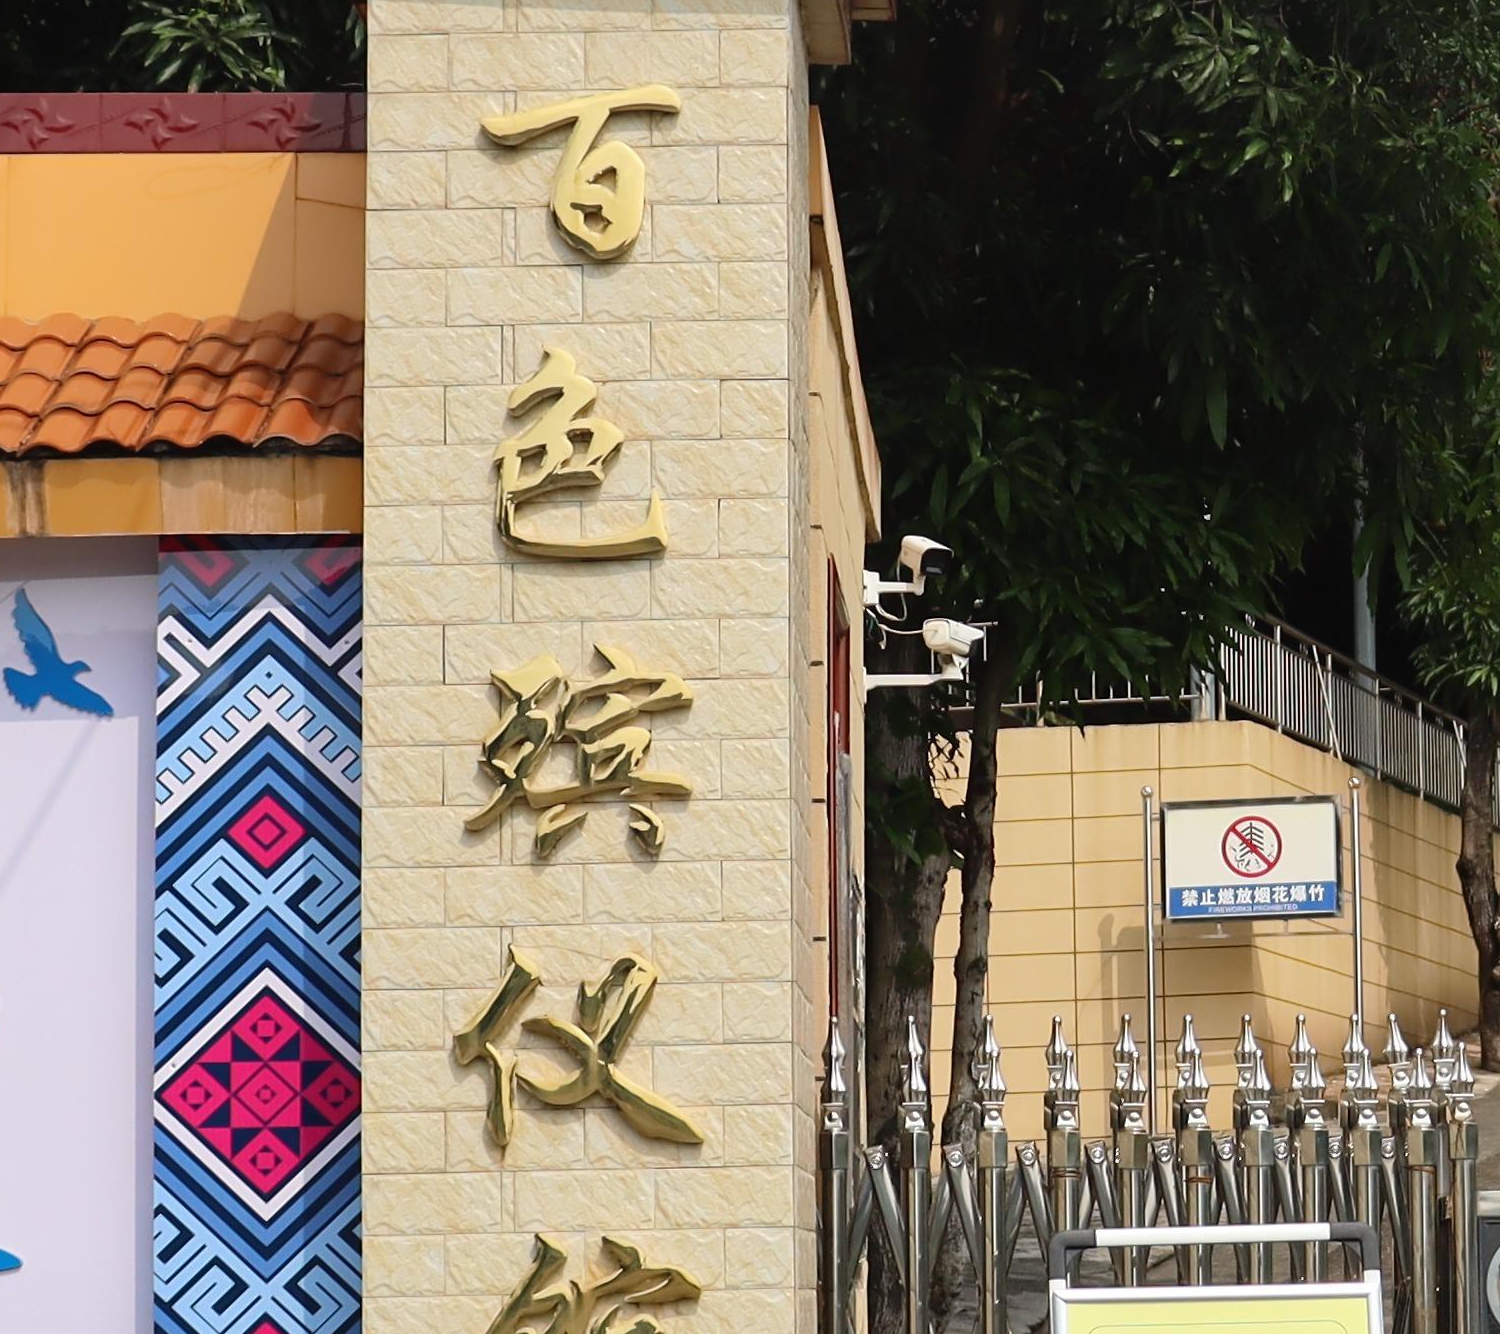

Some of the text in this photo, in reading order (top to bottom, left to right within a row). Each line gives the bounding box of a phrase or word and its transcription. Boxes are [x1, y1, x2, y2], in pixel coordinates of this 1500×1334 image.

[1181, 883, 1325, 907] 禁止燃放烟花爆竹
